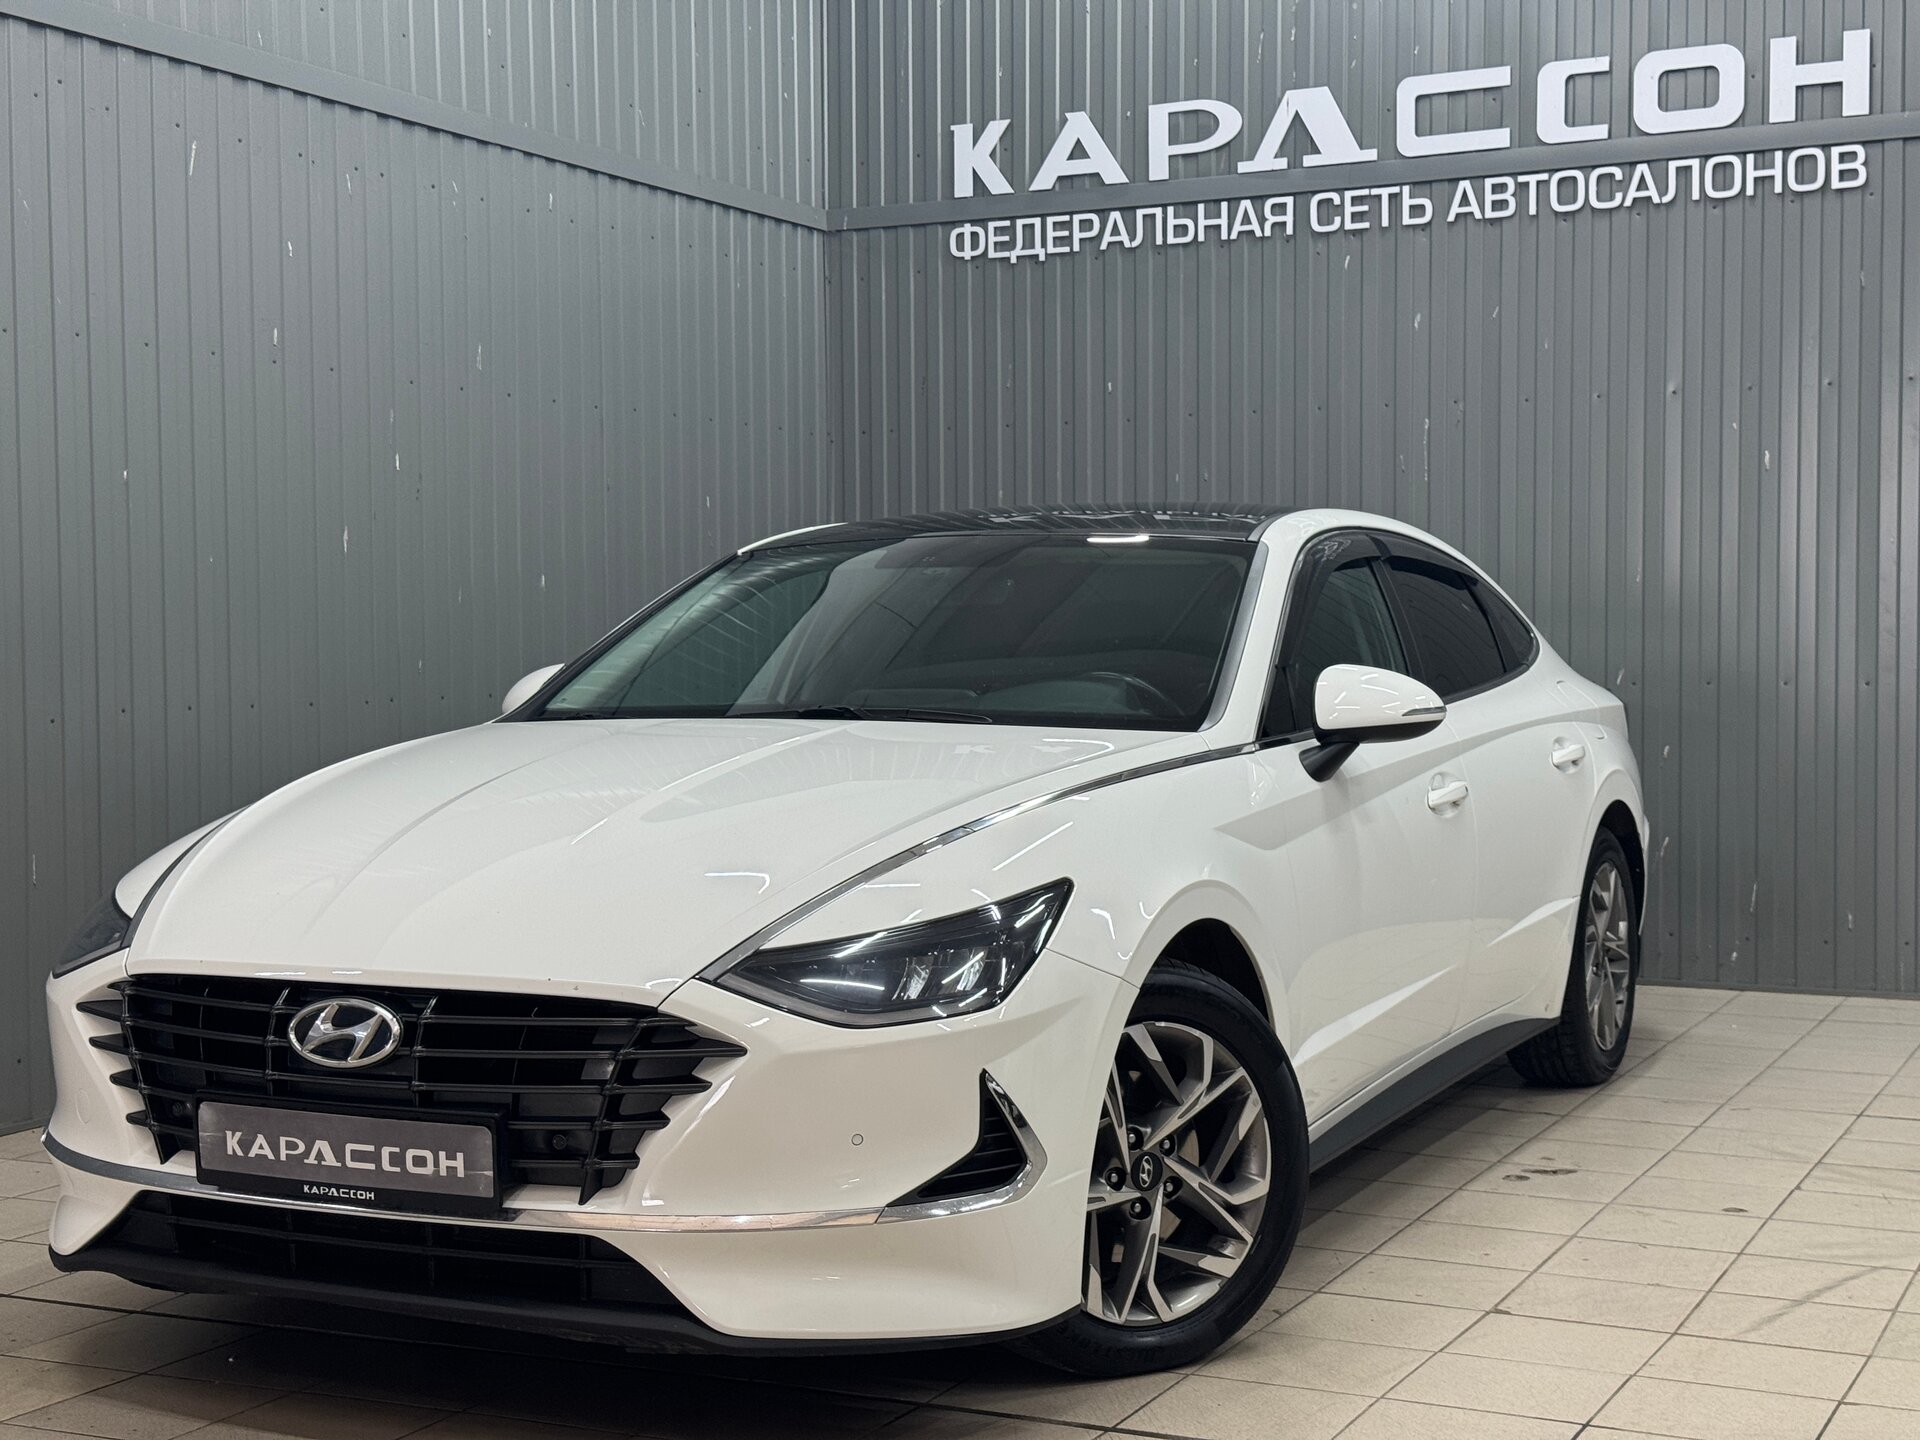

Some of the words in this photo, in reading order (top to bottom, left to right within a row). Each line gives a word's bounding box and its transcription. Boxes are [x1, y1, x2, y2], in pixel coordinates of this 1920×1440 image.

[949, 196, 1294, 263] ФЕДЕРАЛЬНАЯ
[1310, 185, 1433, 232] СЕТЬ
[1446, 144, 1867, 222] АВТОСАЛОНОВ
